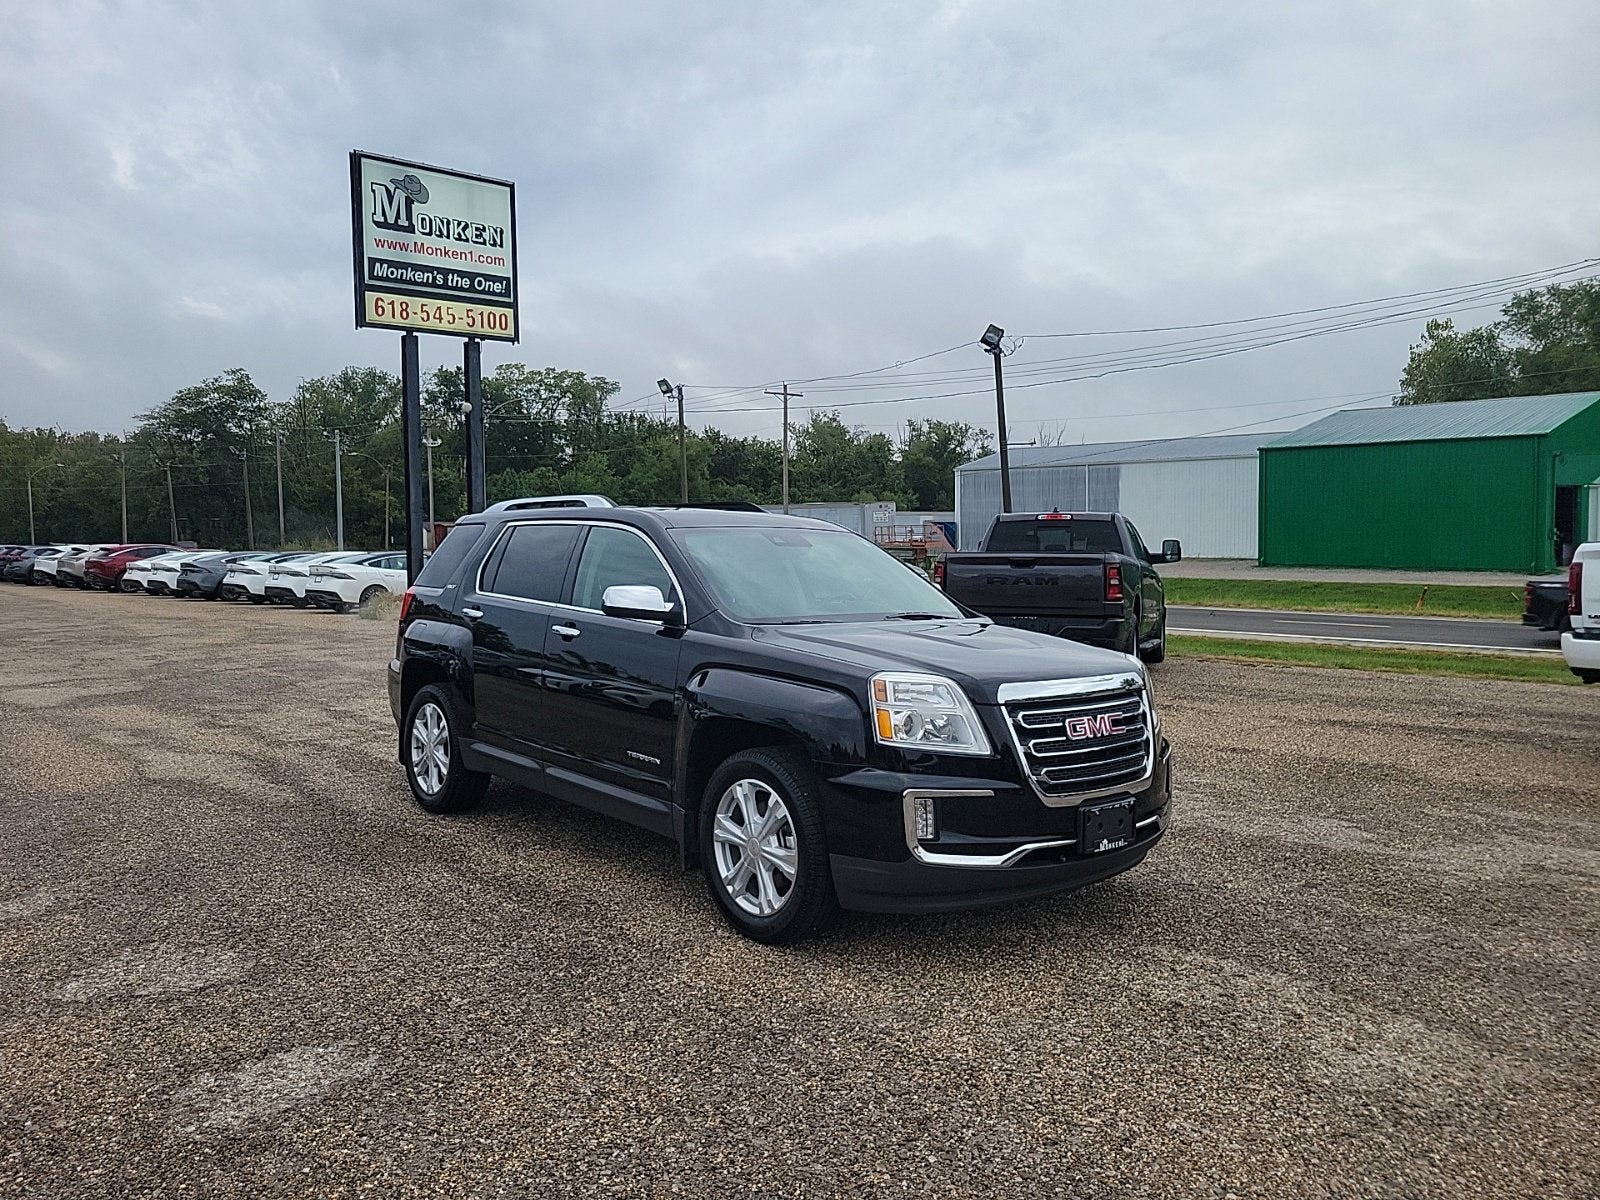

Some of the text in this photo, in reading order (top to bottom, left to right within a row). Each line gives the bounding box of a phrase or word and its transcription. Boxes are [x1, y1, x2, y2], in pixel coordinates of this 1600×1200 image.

[371, 182, 504, 248] MONKEN
[373, 237, 505, 267] www.Monken1.com
[374, 262, 506, 293] Monken's the One!
[374, 297, 509, 331] 618-545-5100
[986, 576, 1060, 586] RAM
[1065, 711, 1126, 740] GMC
